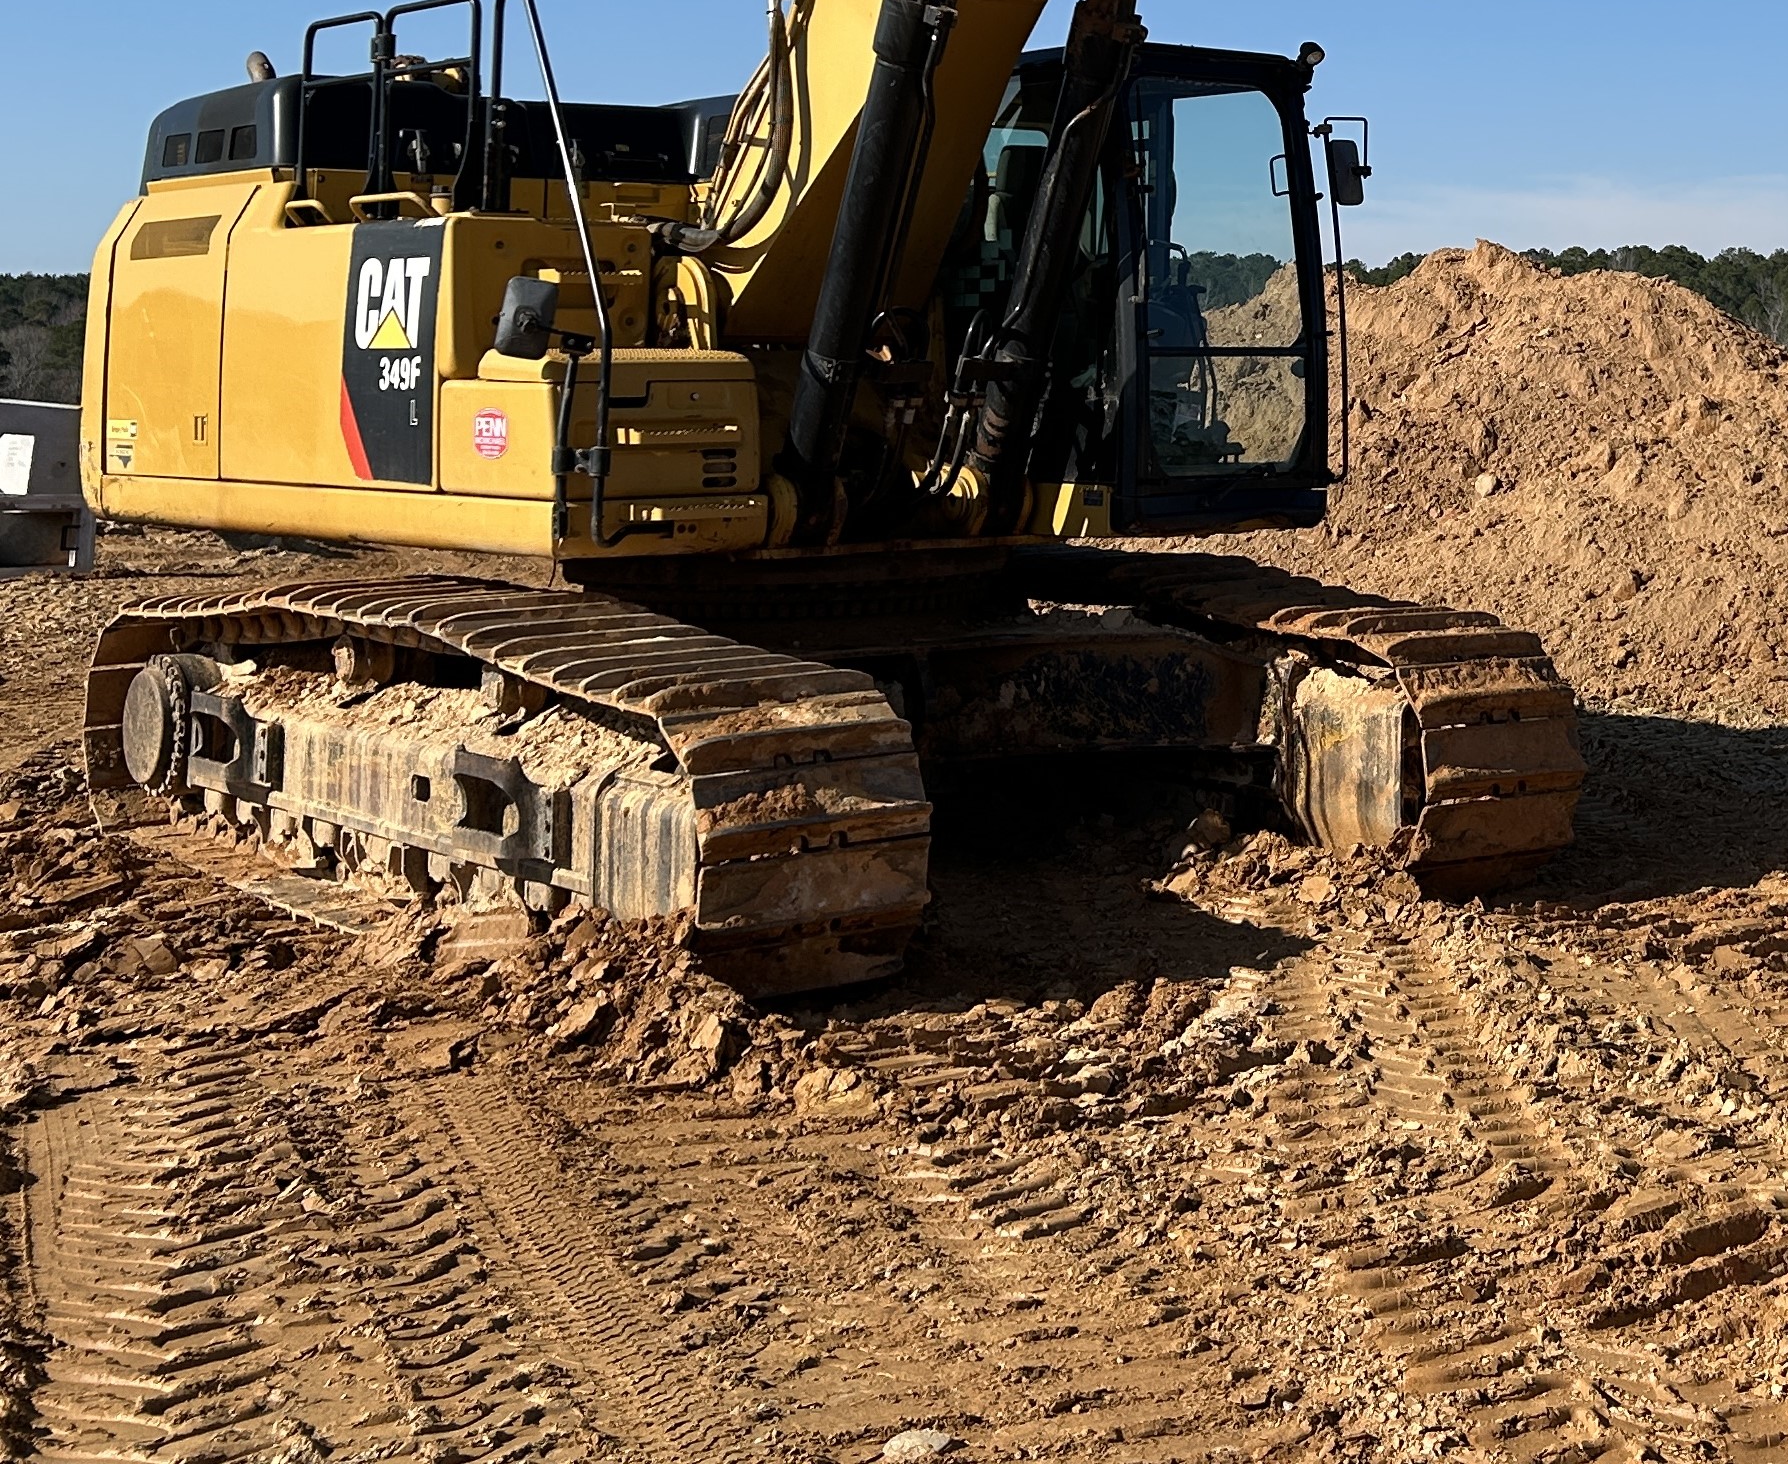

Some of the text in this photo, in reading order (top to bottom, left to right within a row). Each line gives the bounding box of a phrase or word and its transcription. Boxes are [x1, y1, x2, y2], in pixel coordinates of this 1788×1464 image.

[355, 256, 431, 350] CAT
[378, 355, 421, 391] 349F
[409, 399, 418, 426] L
[475, 416, 507, 437] PENN
